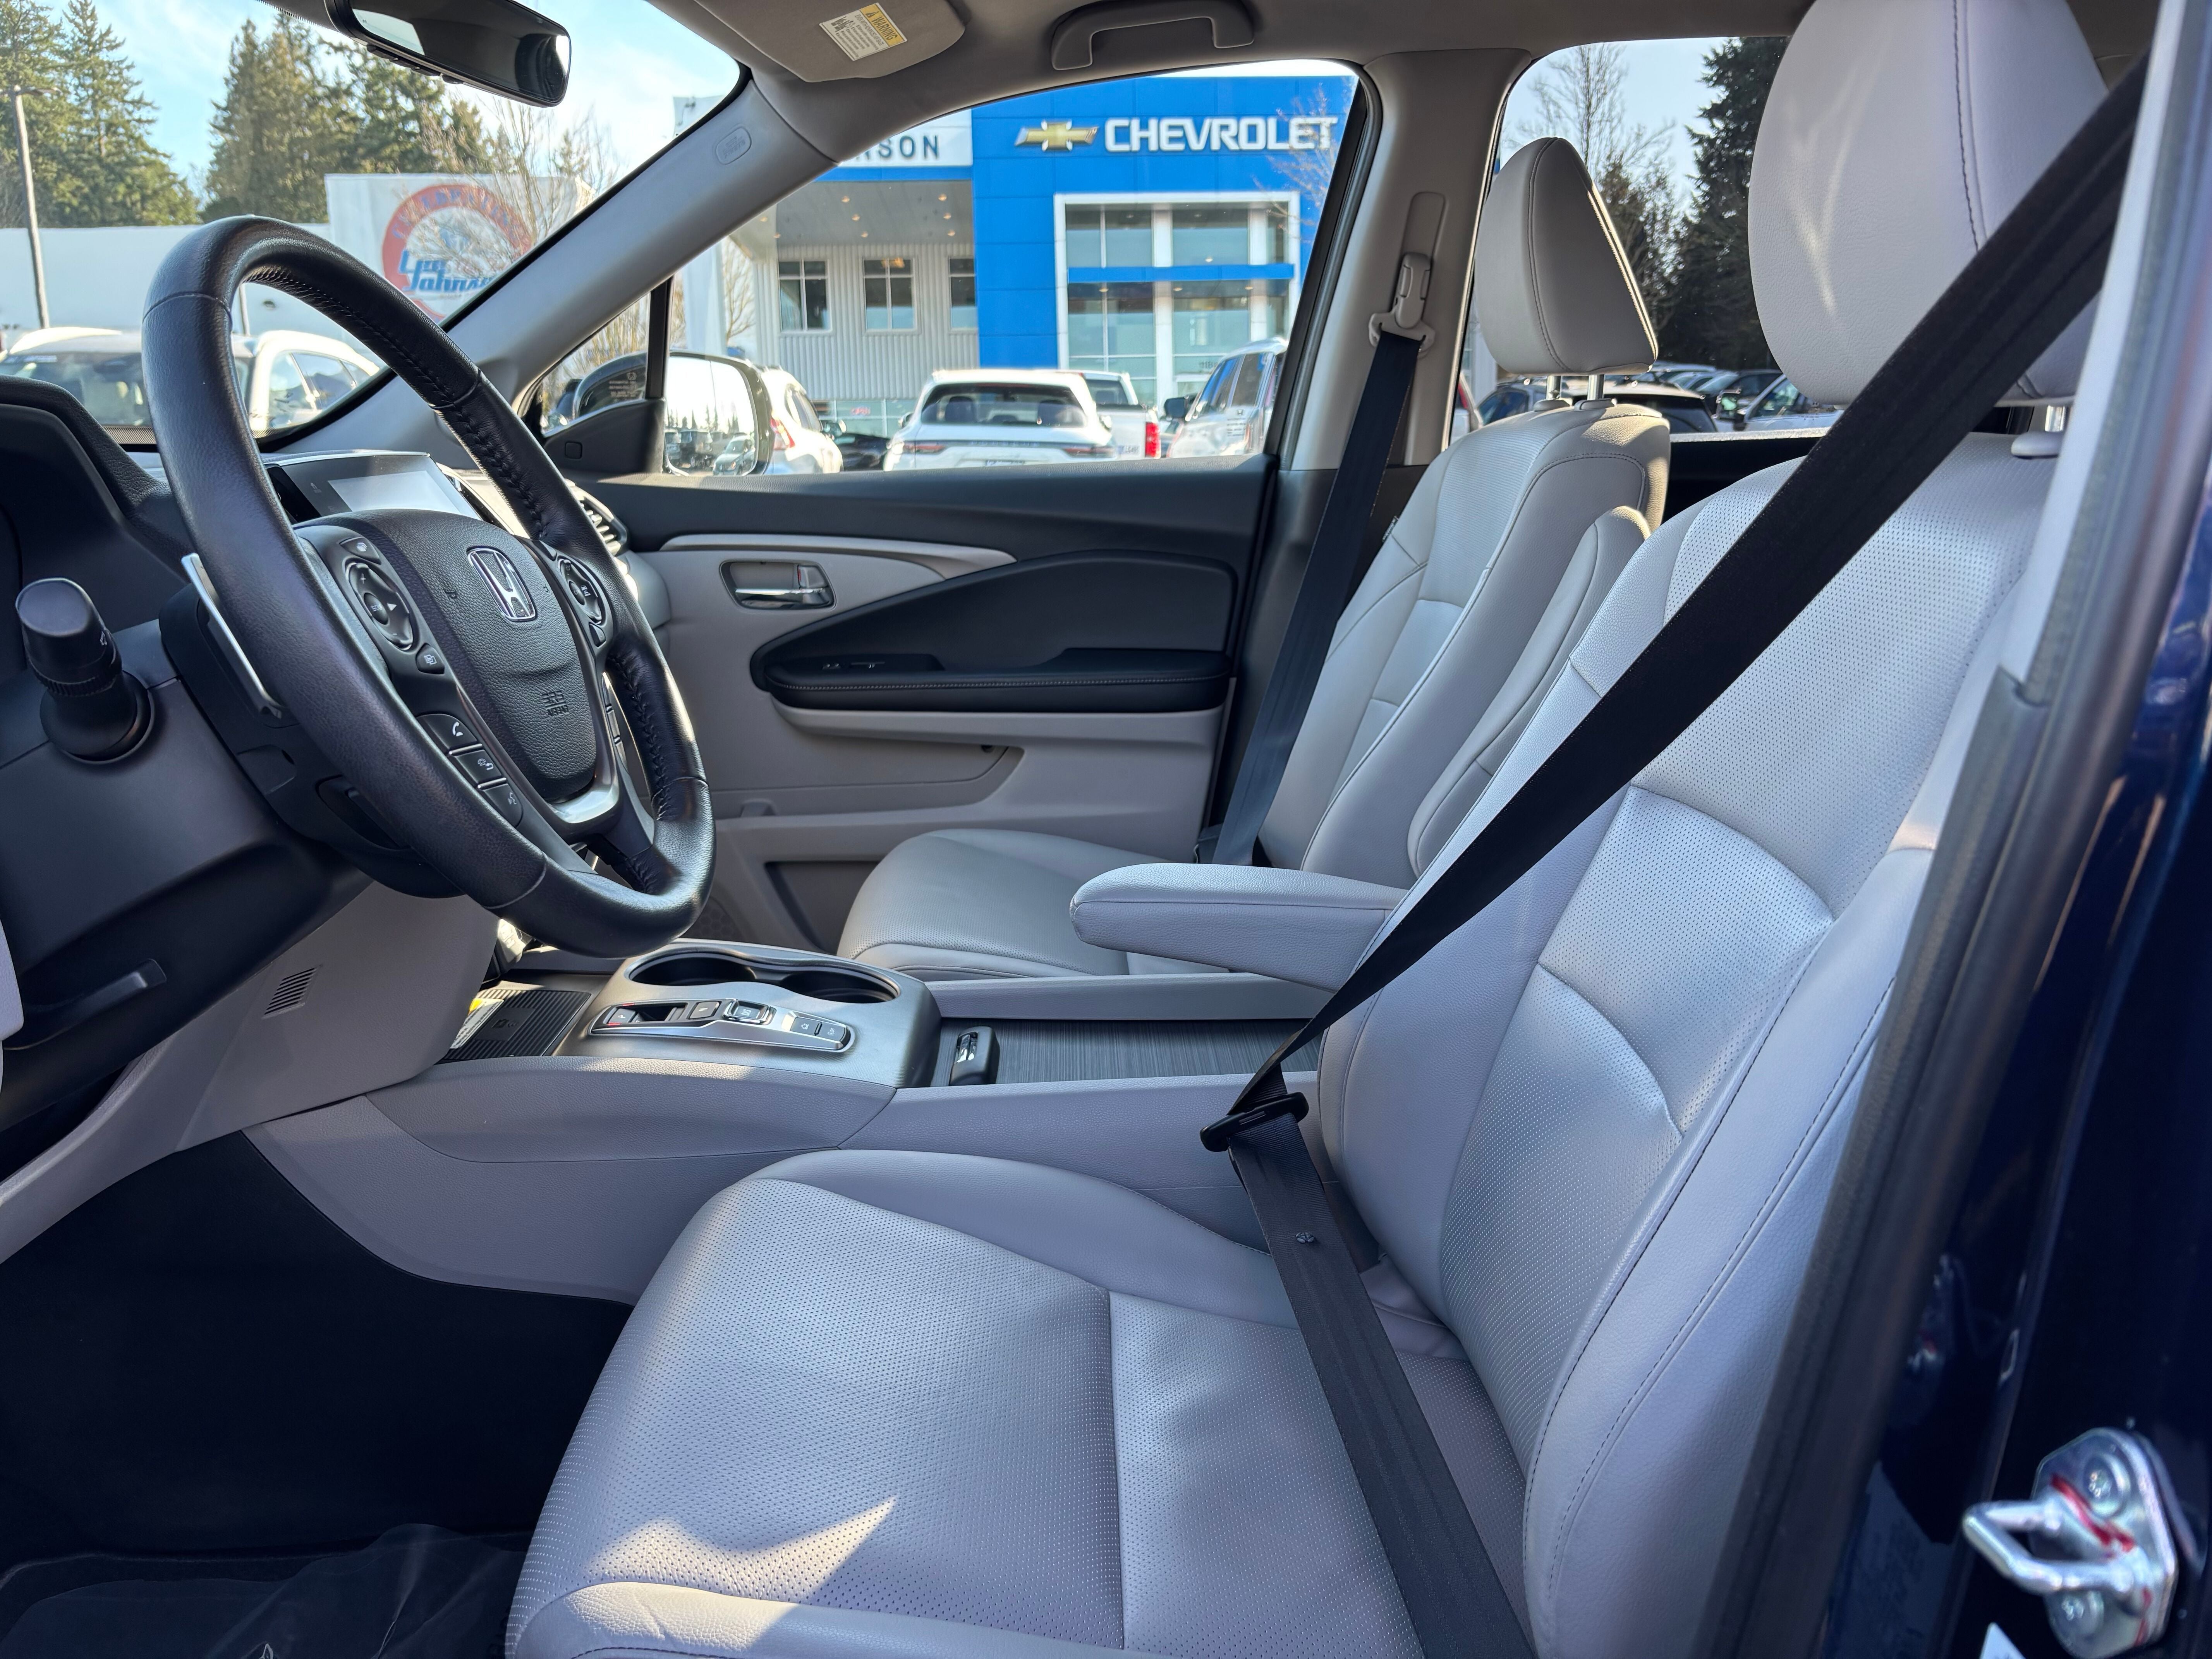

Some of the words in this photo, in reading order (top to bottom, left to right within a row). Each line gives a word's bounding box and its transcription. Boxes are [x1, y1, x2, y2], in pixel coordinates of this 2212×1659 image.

[872, 17, 898, 40] WARNING
[1105, 117, 1338, 151] CHEVROLET
[857, 135, 939, 160] SON
